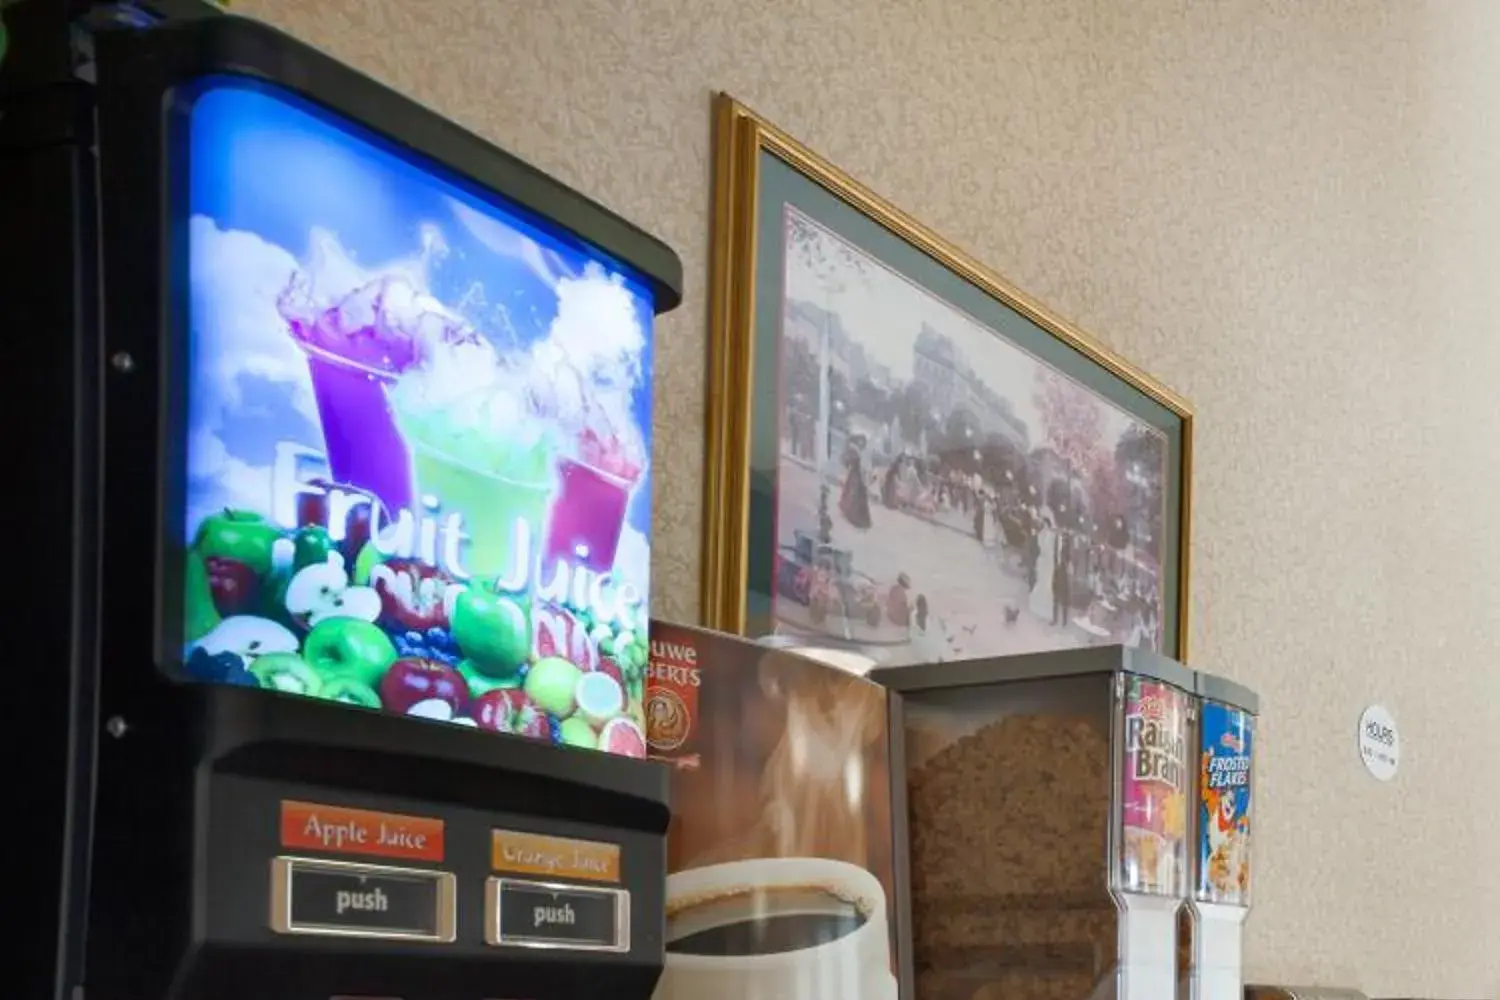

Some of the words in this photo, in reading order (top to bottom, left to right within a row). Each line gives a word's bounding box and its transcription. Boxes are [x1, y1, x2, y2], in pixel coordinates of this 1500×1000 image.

[274, 441, 471, 580] Fruit
[497, 515, 640, 613] Juice
[651, 640, 697, 665] uwe
[1134, 749, 1181, 791] Bran
[303, 813, 368, 848] Apple
[375, 827, 427, 850] Juice
[336, 886, 389, 915] push
[533, 902, 576, 928] push
